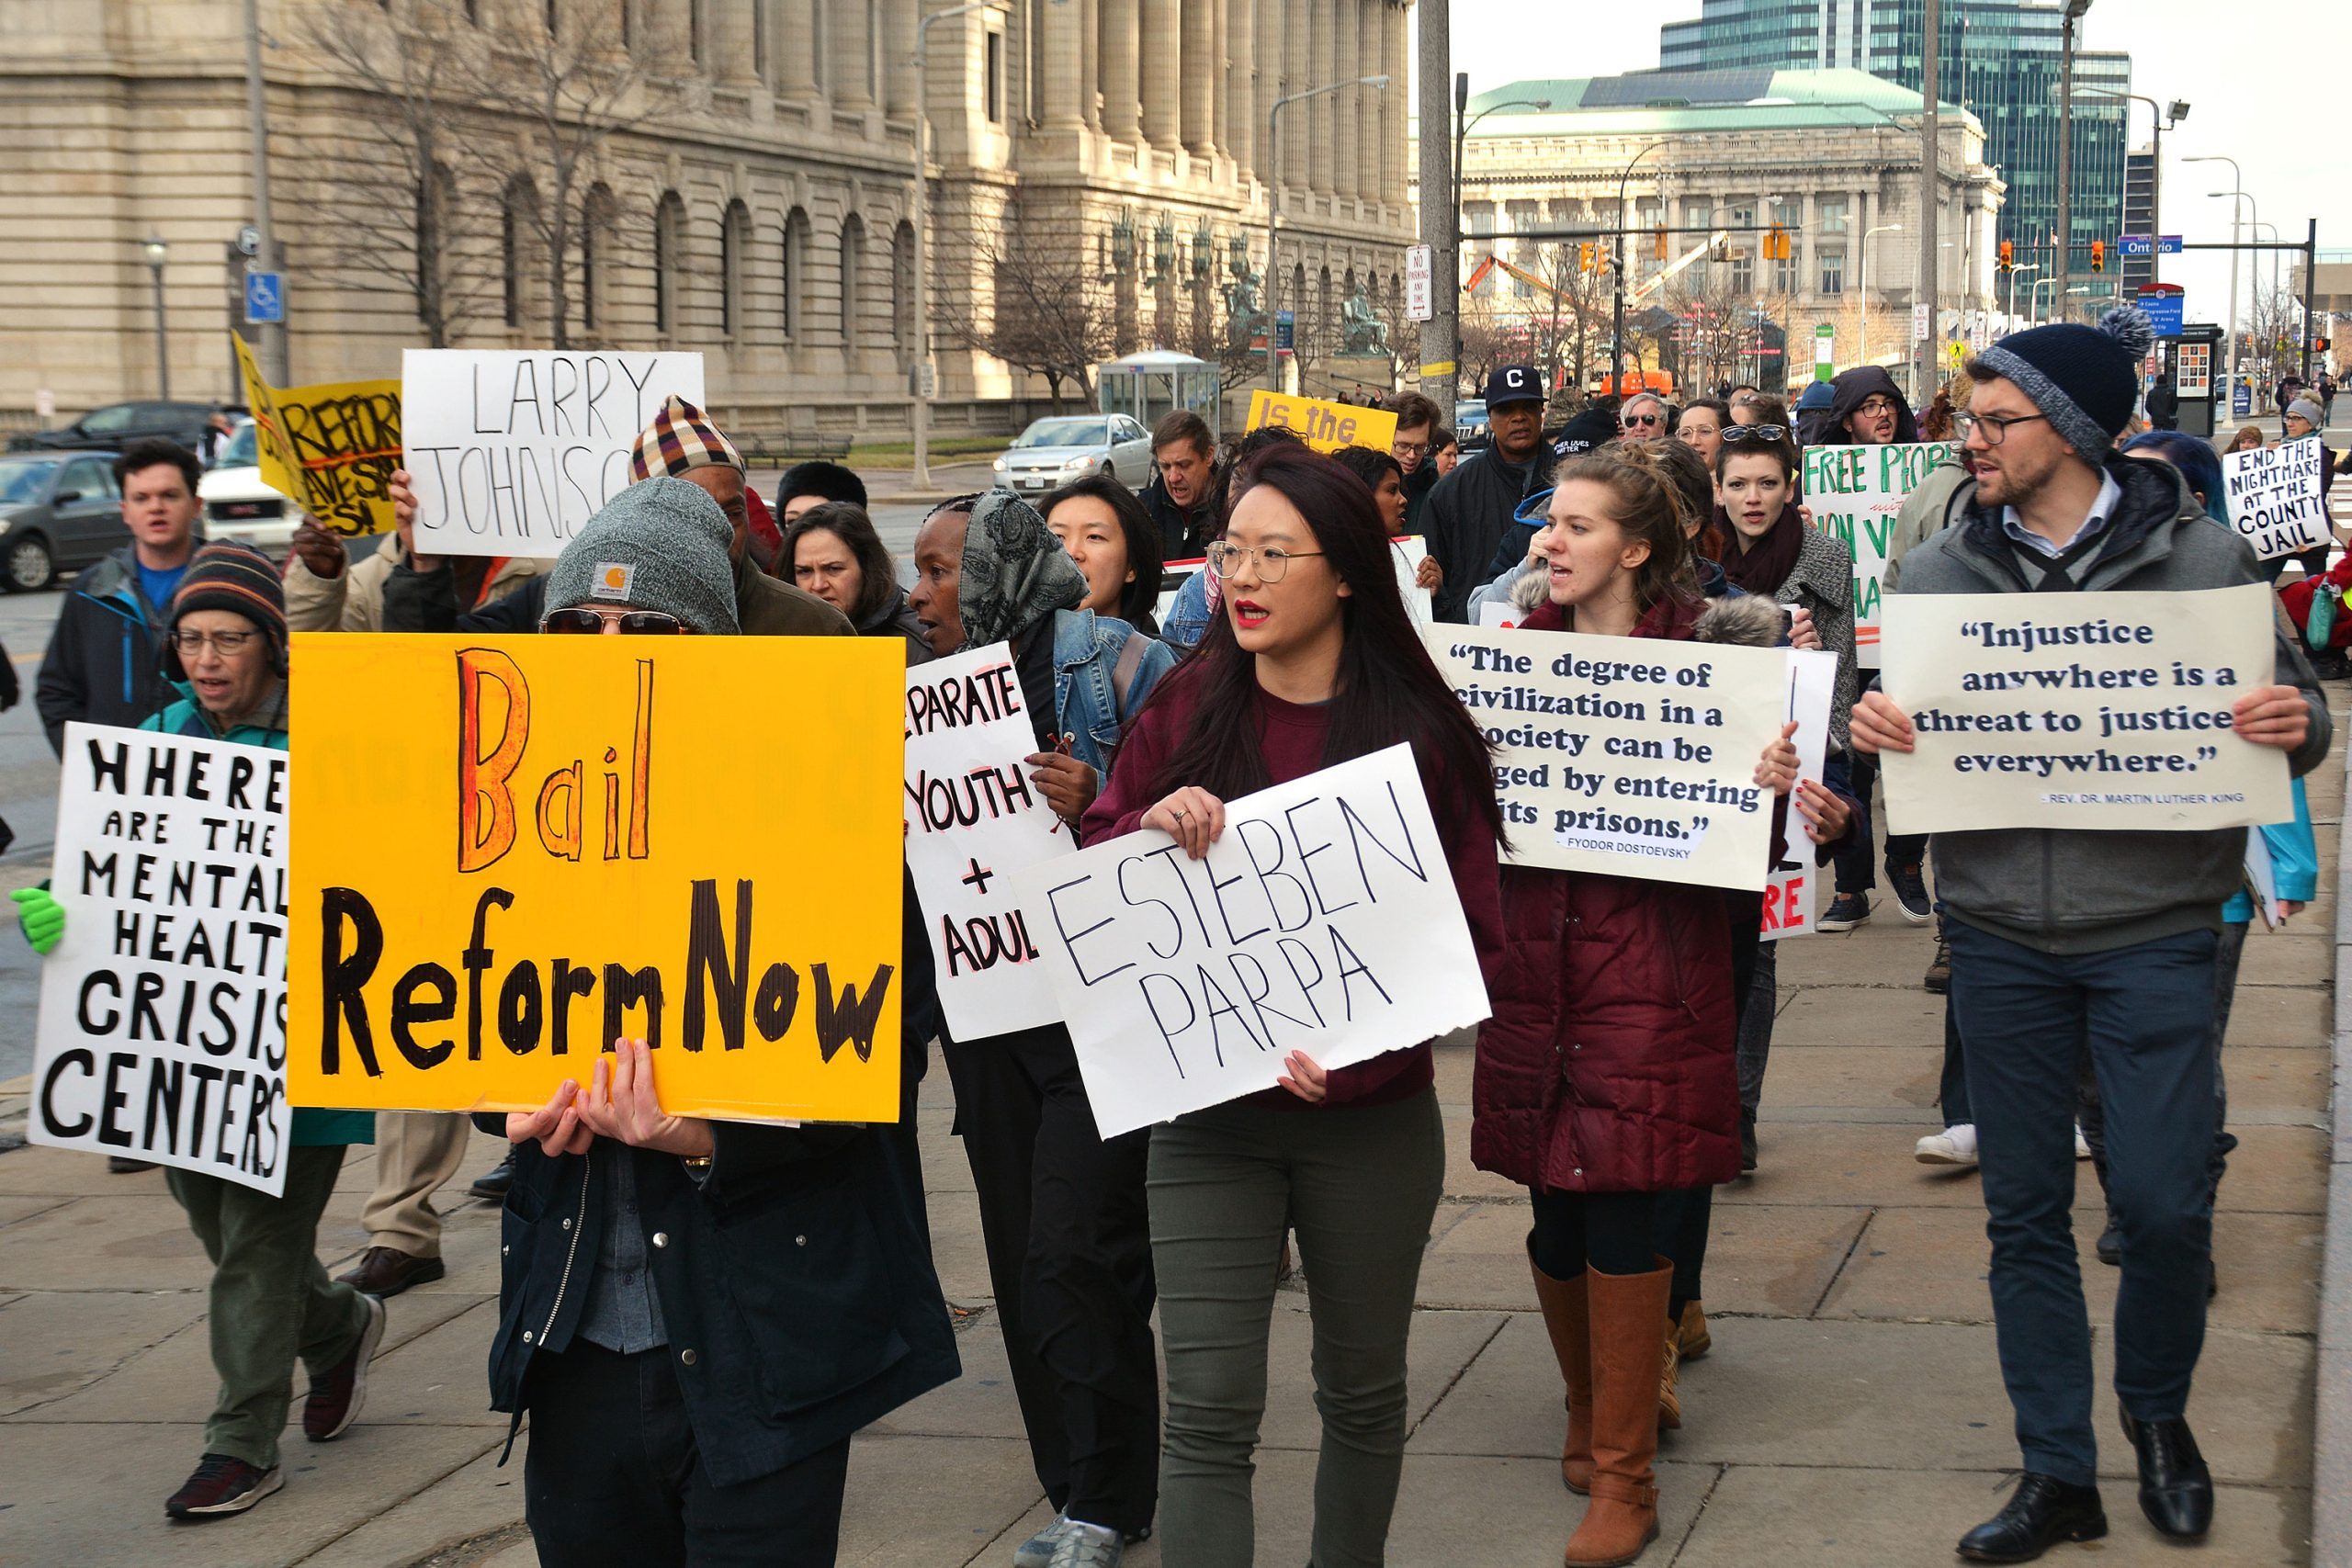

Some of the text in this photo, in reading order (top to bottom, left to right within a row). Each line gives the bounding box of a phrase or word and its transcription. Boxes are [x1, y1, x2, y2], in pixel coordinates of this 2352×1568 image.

[1413, 254, 1423, 268] NO
[2128, 242, 2172, 253] Ontrio
[475, 356, 657, 439] LARRY
[1506, 369, 1523, 388] C
[1259, 398, 1357, 444] Is the
[1804, 444, 1953, 495] FREE PEOP
[2230, 459, 2320, 496] NIGHTMARE
[2239, 440, 2313, 471] END THE
[412, 446, 631, 540] JOHNSO
[2238, 494, 2320, 535] COUNTY
[2244, 479, 2309, 510] AT THE
[2258, 523, 2316, 555] JAIL
[1961, 619, 2154, 653] “Injustice
[1450, 644, 1713, 688] “The degree of
[1962, 661, 2237, 691] anywhere is a
[905, 663, 1022, 740] PARATE
[1453, 683, 1724, 727] civilization in a
[1911, 705, 2234, 738] threat to justice
[456, 647, 654, 874] Bail
[1482, 724, 1713, 762] ociety can be
[87, 739, 286, 814] WHERE
[905, 762, 1035, 833] YOUTH
[1495, 764, 1761, 813] ged by entering
[2050, 794, 2075, 804] REV.
[2080, 794, 2100, 804] DR.
[2105, 794, 2153, 804] MARTIN
[2155, 794, 2206, 804] LUTHER
[2211, 793, 2245, 803] KING
[102, 809, 276, 858] ARE THE
[1568, 838, 1614, 852] FYODOR
[1617, 841, 1691, 859] DOSTOEVSKY
[81, 851, 288, 917] MENTAL
[1047, 781, 1428, 987] ESTEBEN
[114, 909, 288, 982] HEALT
[942, 908, 1040, 978] ADUL
[322, 878, 894, 1078] Reform Now
[1139, 924, 1393, 1079] PARPA
[78, 969, 287, 1071] CRISIS
[40, 1048, 285, 1179] CENTERS
